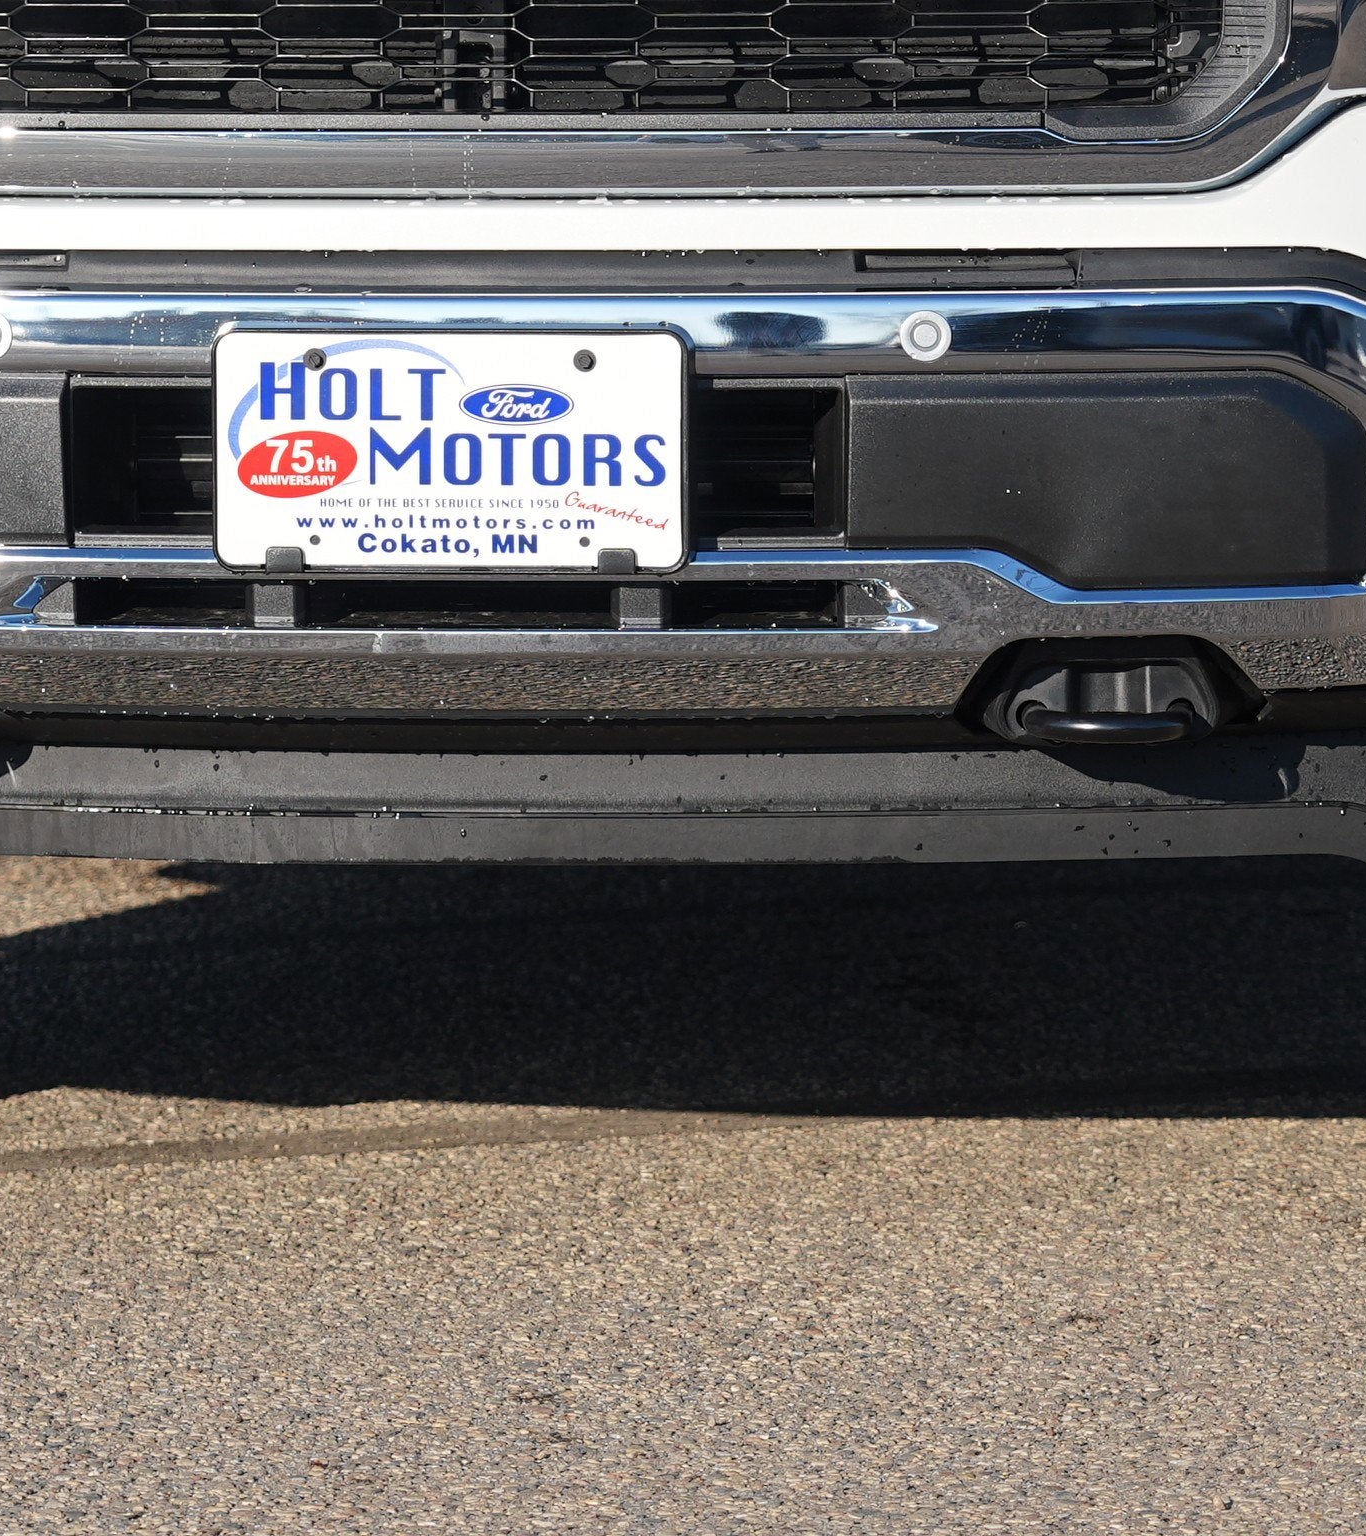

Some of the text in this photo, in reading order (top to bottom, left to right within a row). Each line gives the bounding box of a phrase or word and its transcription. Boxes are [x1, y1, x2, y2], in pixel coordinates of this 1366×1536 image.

[260, 362, 446, 421] HOLT
[481, 389, 552, 419] Ford
[265, 439, 337, 474] 75th
[370, 427, 667, 487] MOTORS
[250, 474, 337, 486] ANNIVERSARY
[320, 497, 560, 509] HOME OF THE BEST SERVICE SINCE 1950
[565, 491, 670, 531] Guaranteed
[296, 514, 596, 530] www.holtmotors.com
[357, 532, 538, 557] Cokato, MN
